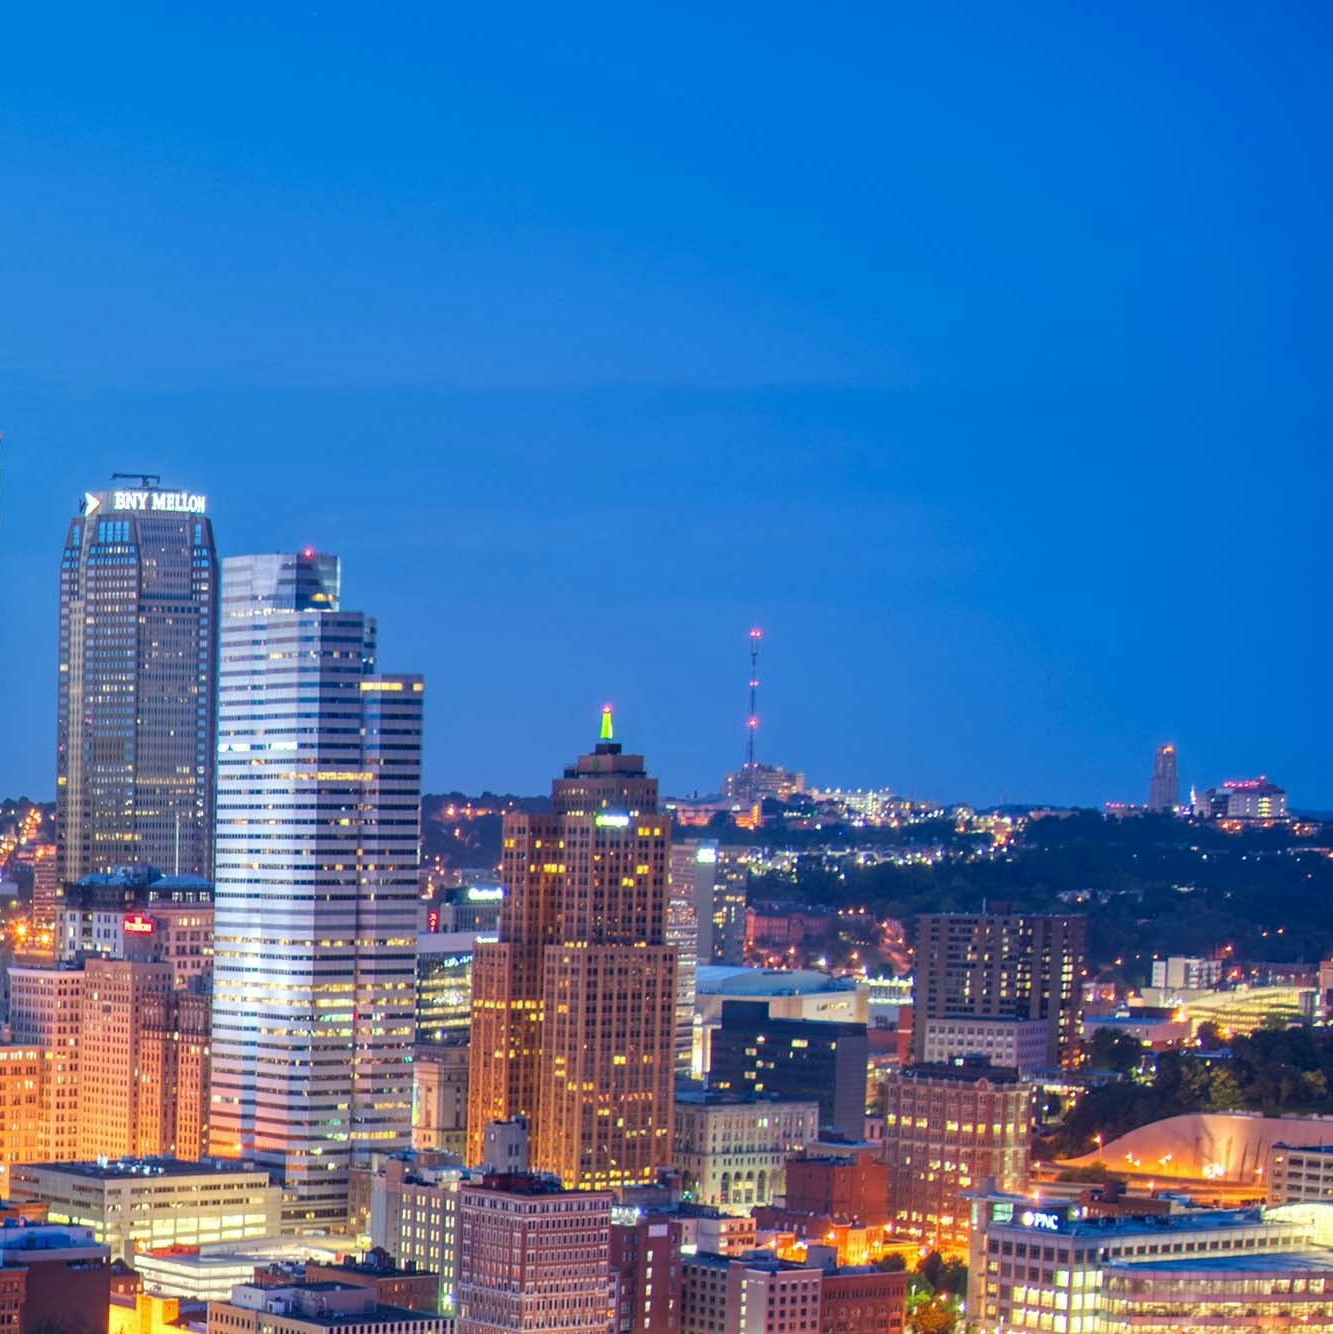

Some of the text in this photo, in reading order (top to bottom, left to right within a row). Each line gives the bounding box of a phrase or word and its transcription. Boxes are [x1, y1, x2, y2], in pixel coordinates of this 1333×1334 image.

[114, 492, 205, 514] BNY MELLON
[1034, 1212, 1059, 1230] PNC
